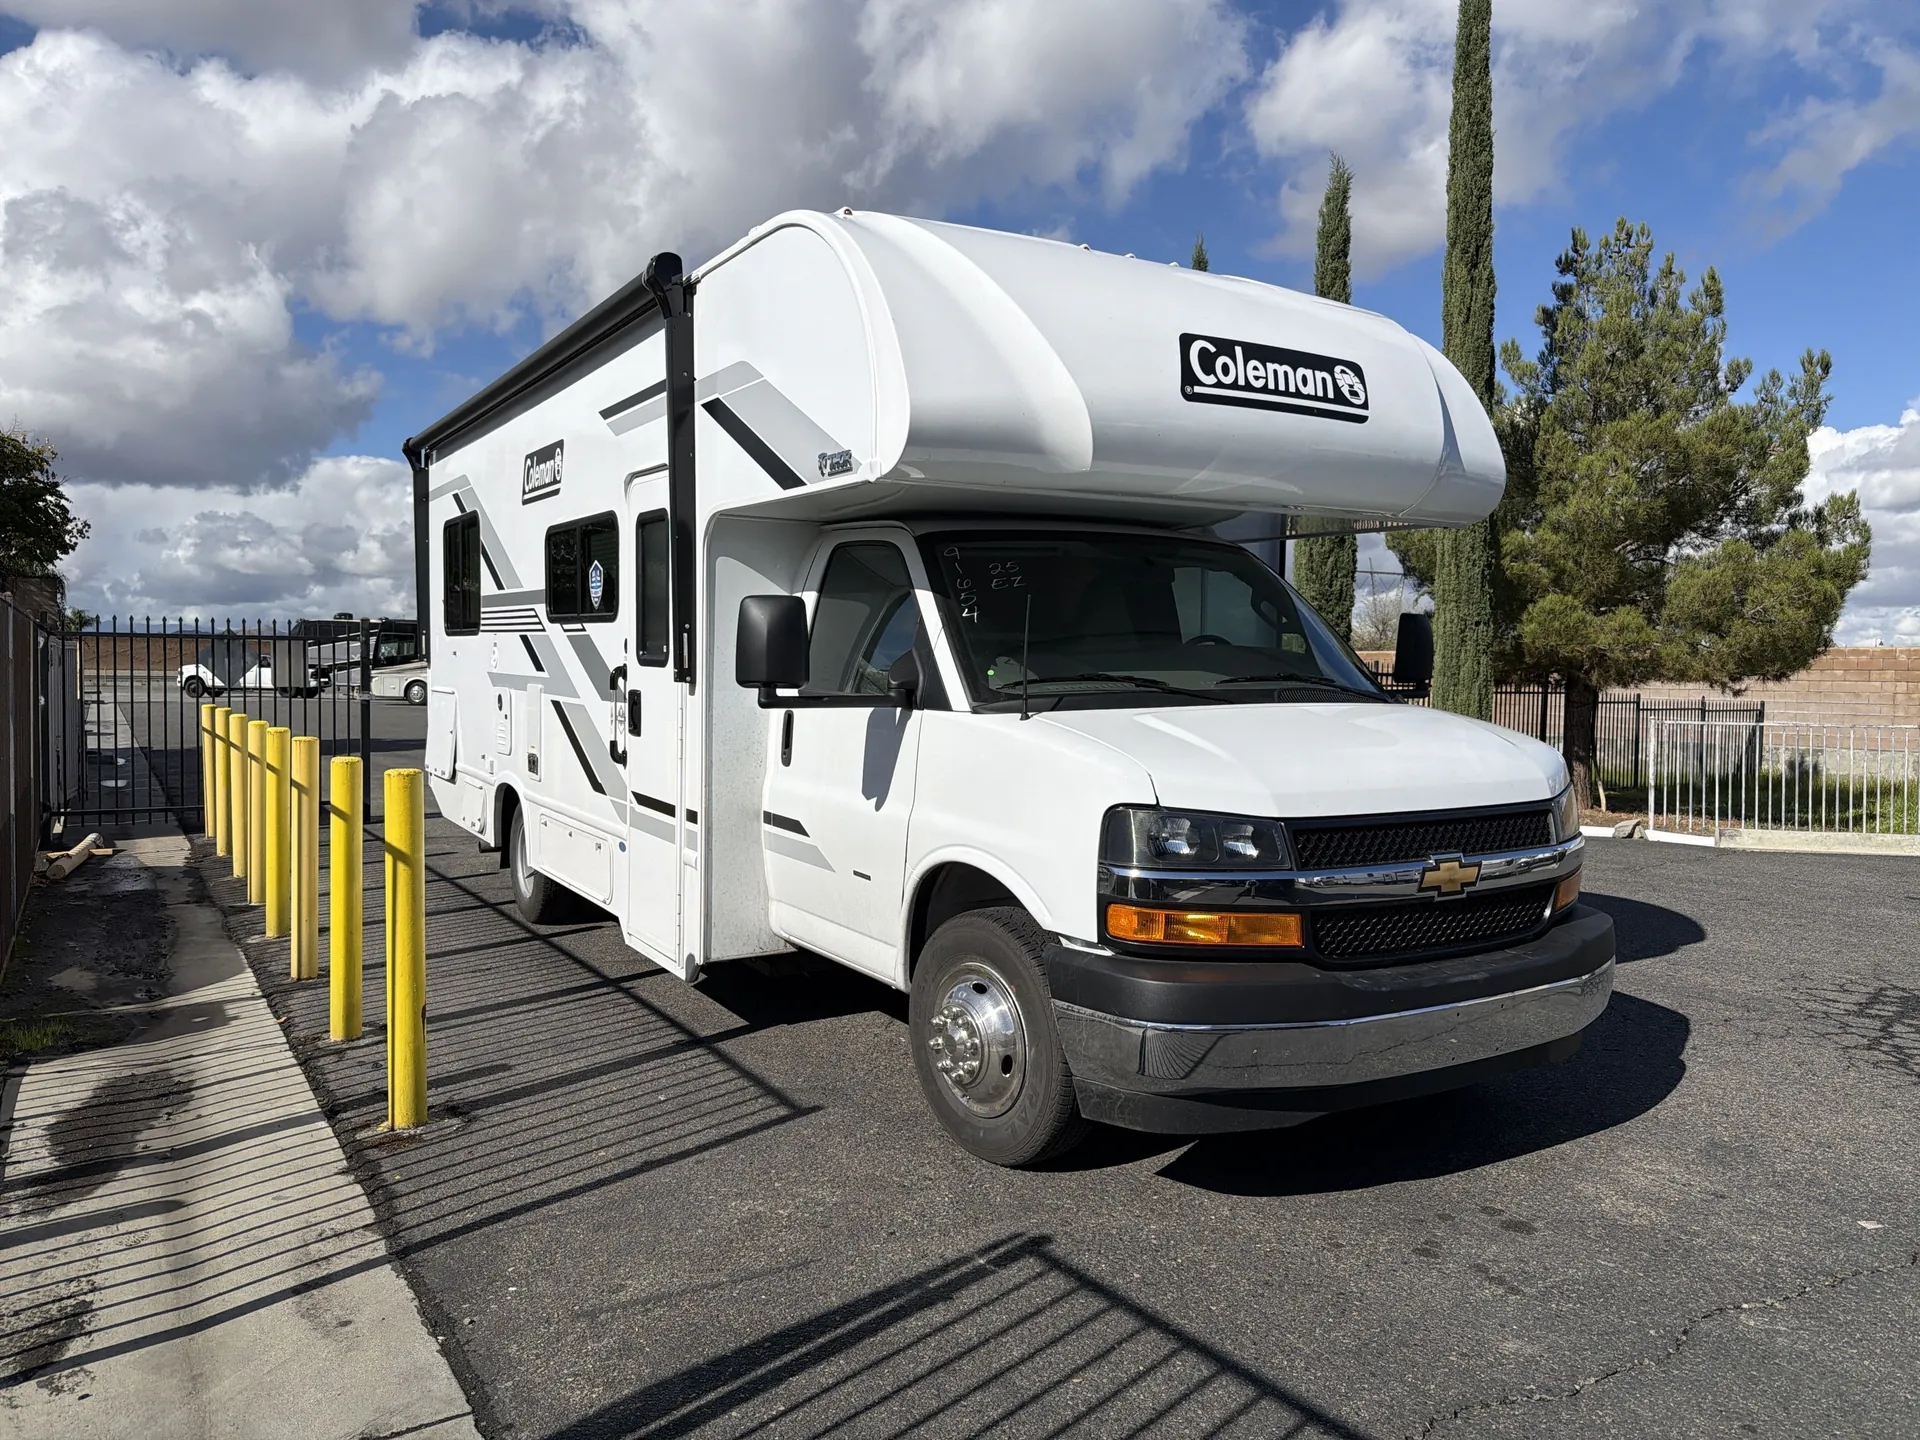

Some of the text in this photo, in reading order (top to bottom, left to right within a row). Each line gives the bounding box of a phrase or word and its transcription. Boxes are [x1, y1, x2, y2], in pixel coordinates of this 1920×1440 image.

[1189, 339, 1335, 399] Coleman
[524, 455, 555, 493] Coleman
[988, 560, 1023, 575] 25
